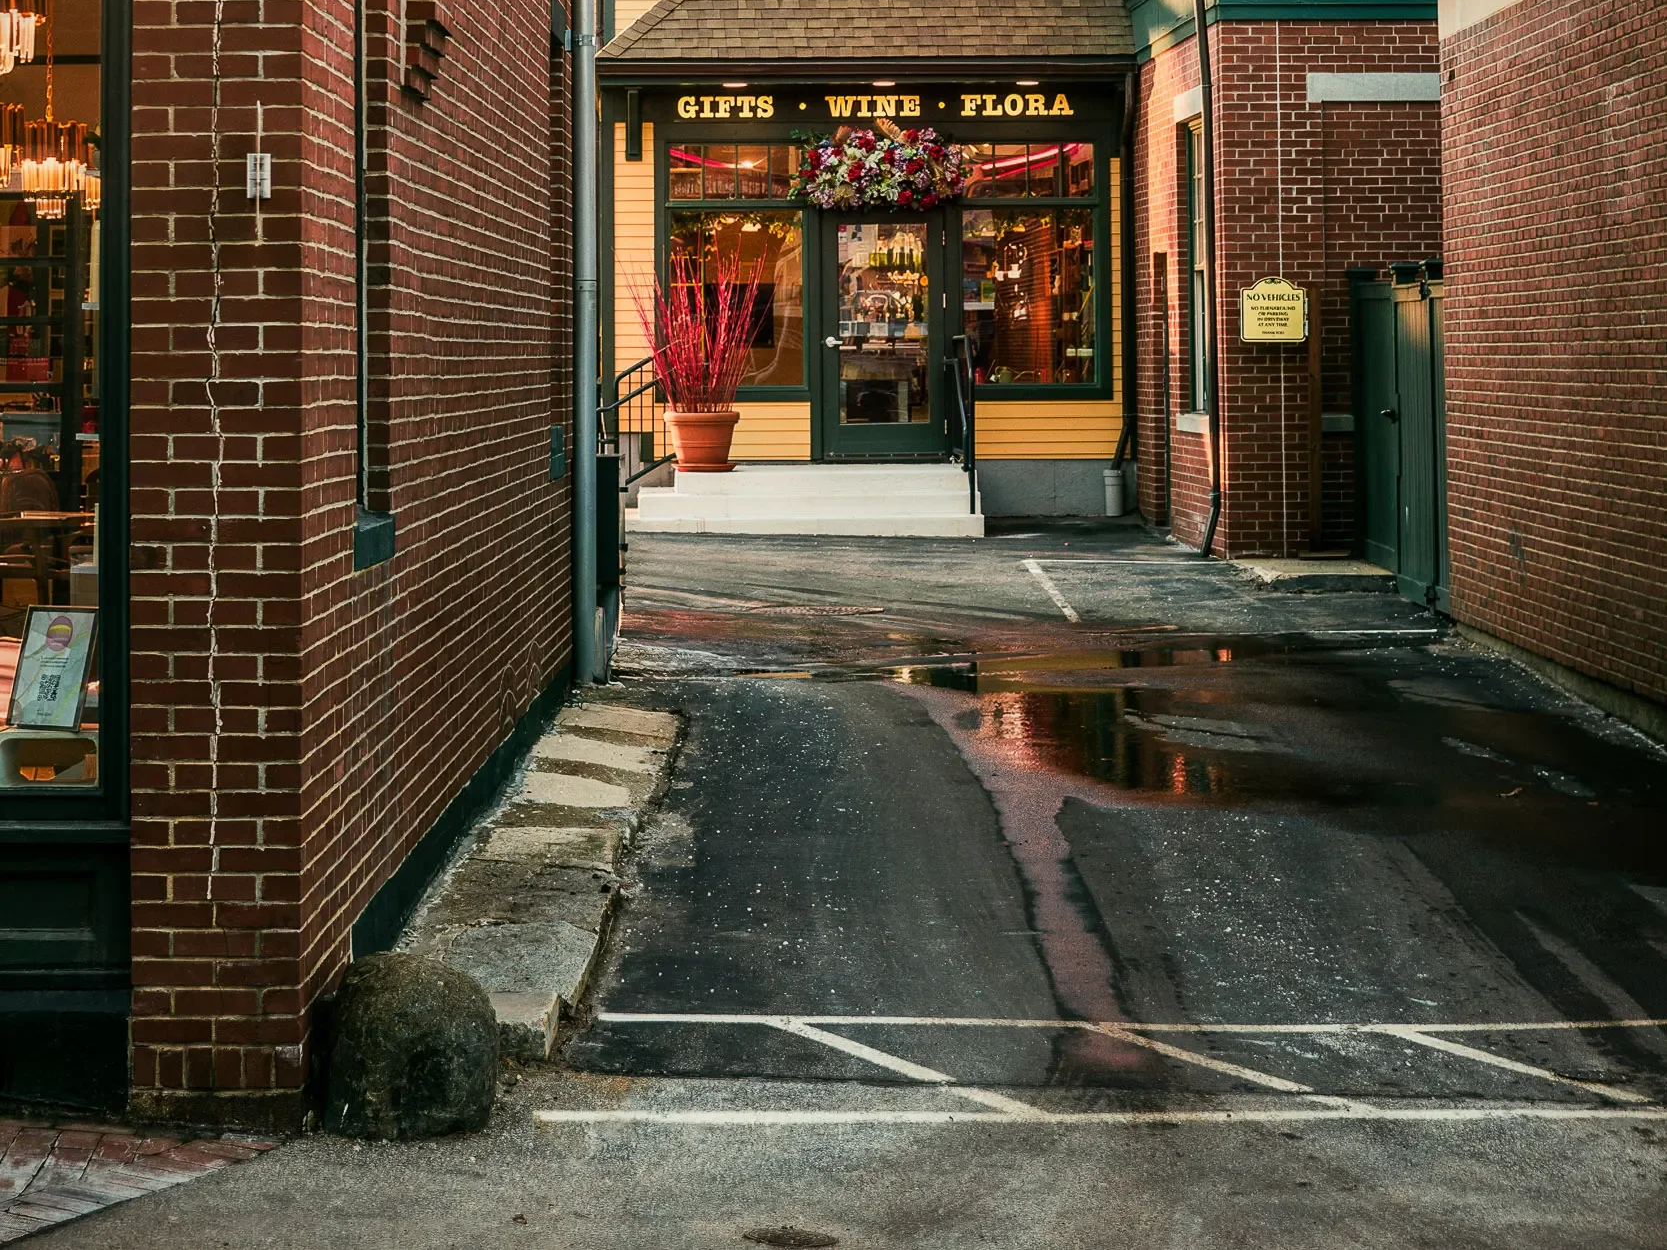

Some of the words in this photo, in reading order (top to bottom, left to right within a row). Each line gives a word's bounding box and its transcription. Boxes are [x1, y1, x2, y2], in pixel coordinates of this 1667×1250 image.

[677, 95, 774, 119] GIFTS
[825, 95, 921, 118] WINE
[960, 93, 1074, 117] FLORA
[1246, 293, 1260, 301] NO
[1261, 293, 1301, 301] VEHICLES
